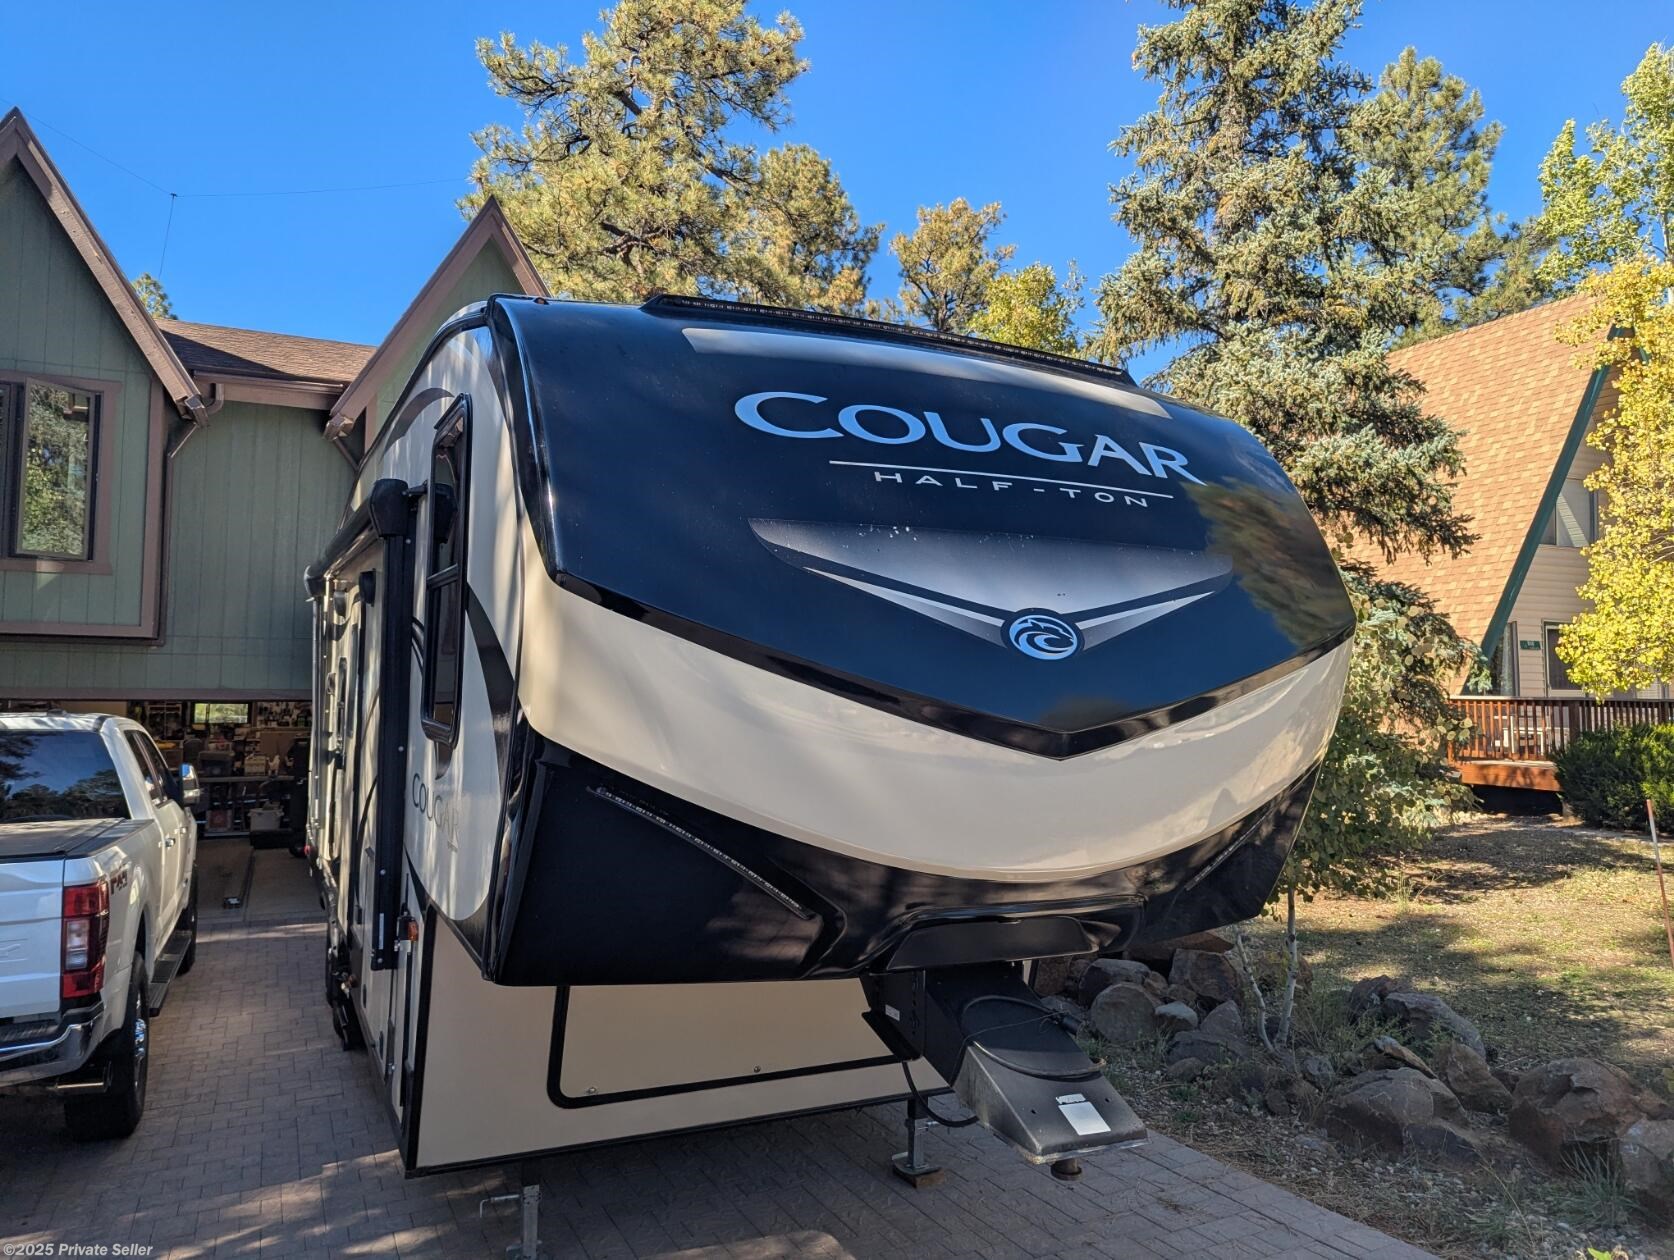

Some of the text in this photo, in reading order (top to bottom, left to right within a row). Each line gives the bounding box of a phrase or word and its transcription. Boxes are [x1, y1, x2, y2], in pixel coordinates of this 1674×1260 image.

[734, 391, 1207, 486] COUGAR
[873, 471, 1149, 507] HALF-TON
[412, 772, 459, 845] COUGAR
